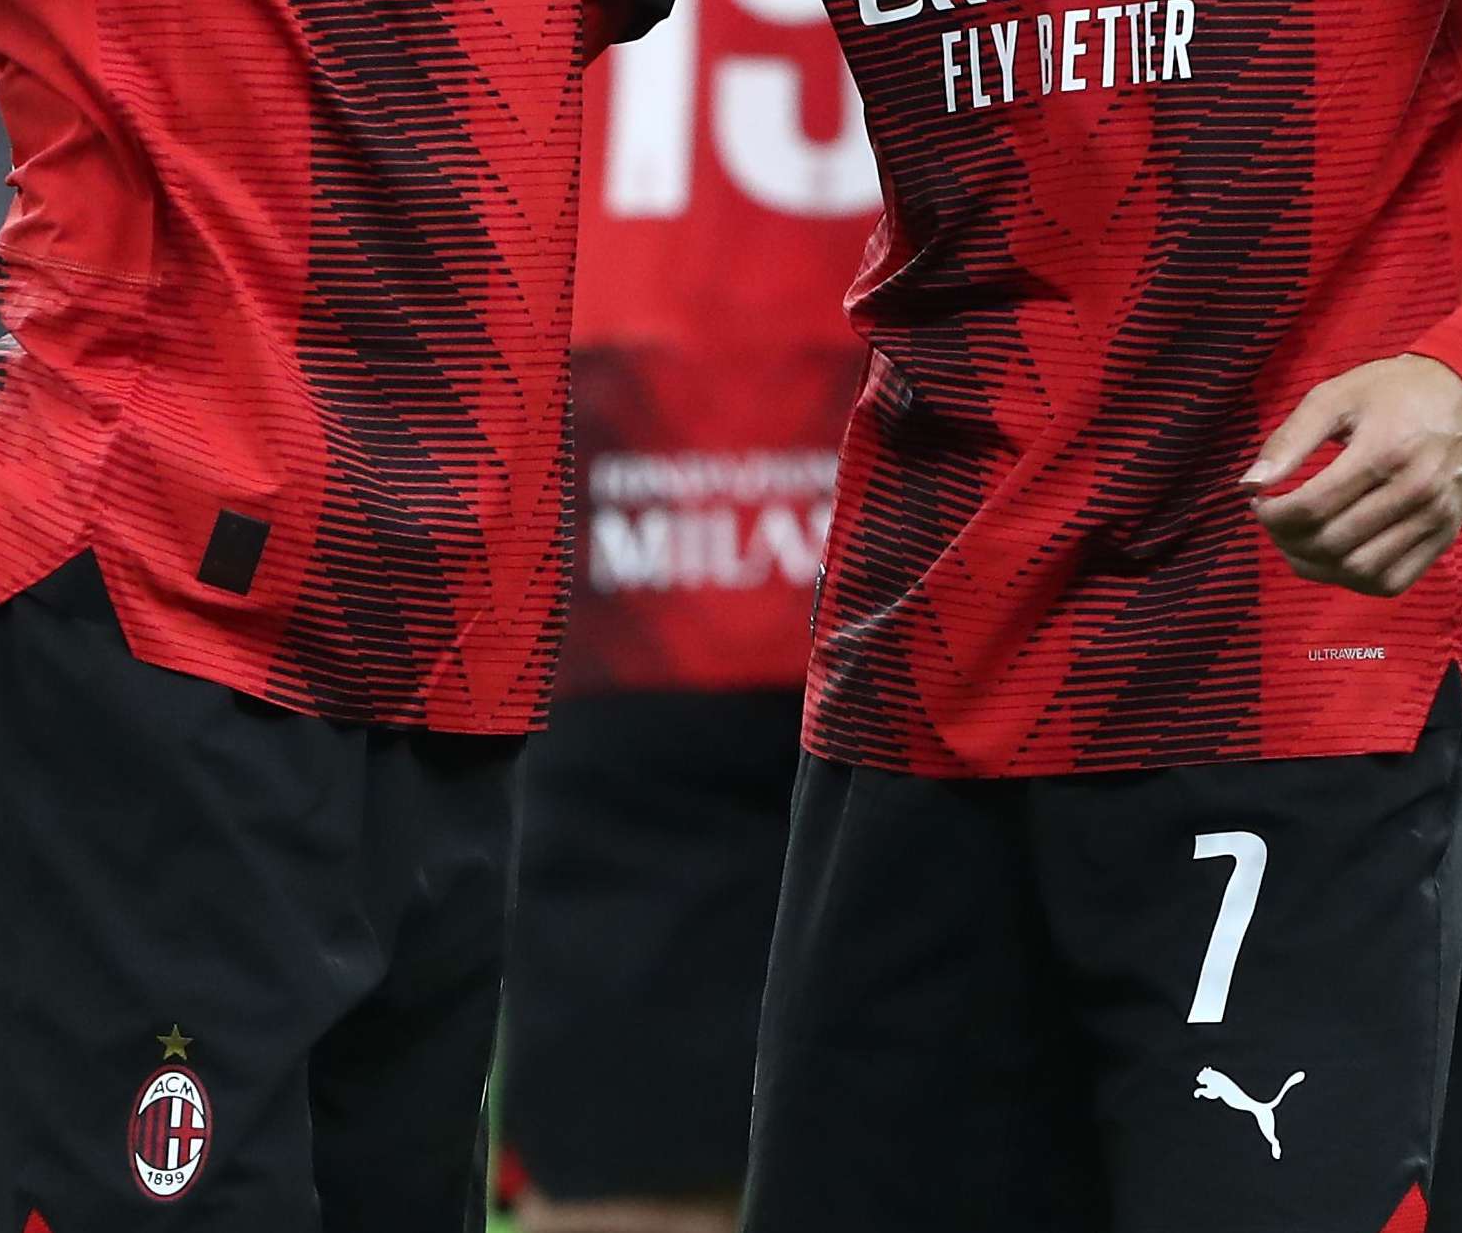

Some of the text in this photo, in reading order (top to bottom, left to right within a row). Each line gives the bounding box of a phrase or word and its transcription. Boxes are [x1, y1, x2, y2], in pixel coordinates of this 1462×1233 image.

[940, 20, 1020, 113] FLY
[1308, 647, 1386, 662] ULTRAWEAVE
[1185, 830, 1268, 1025] 7
[150, 1076, 195, 1101] ACM
[147, 1171, 185, 1186] 1899
